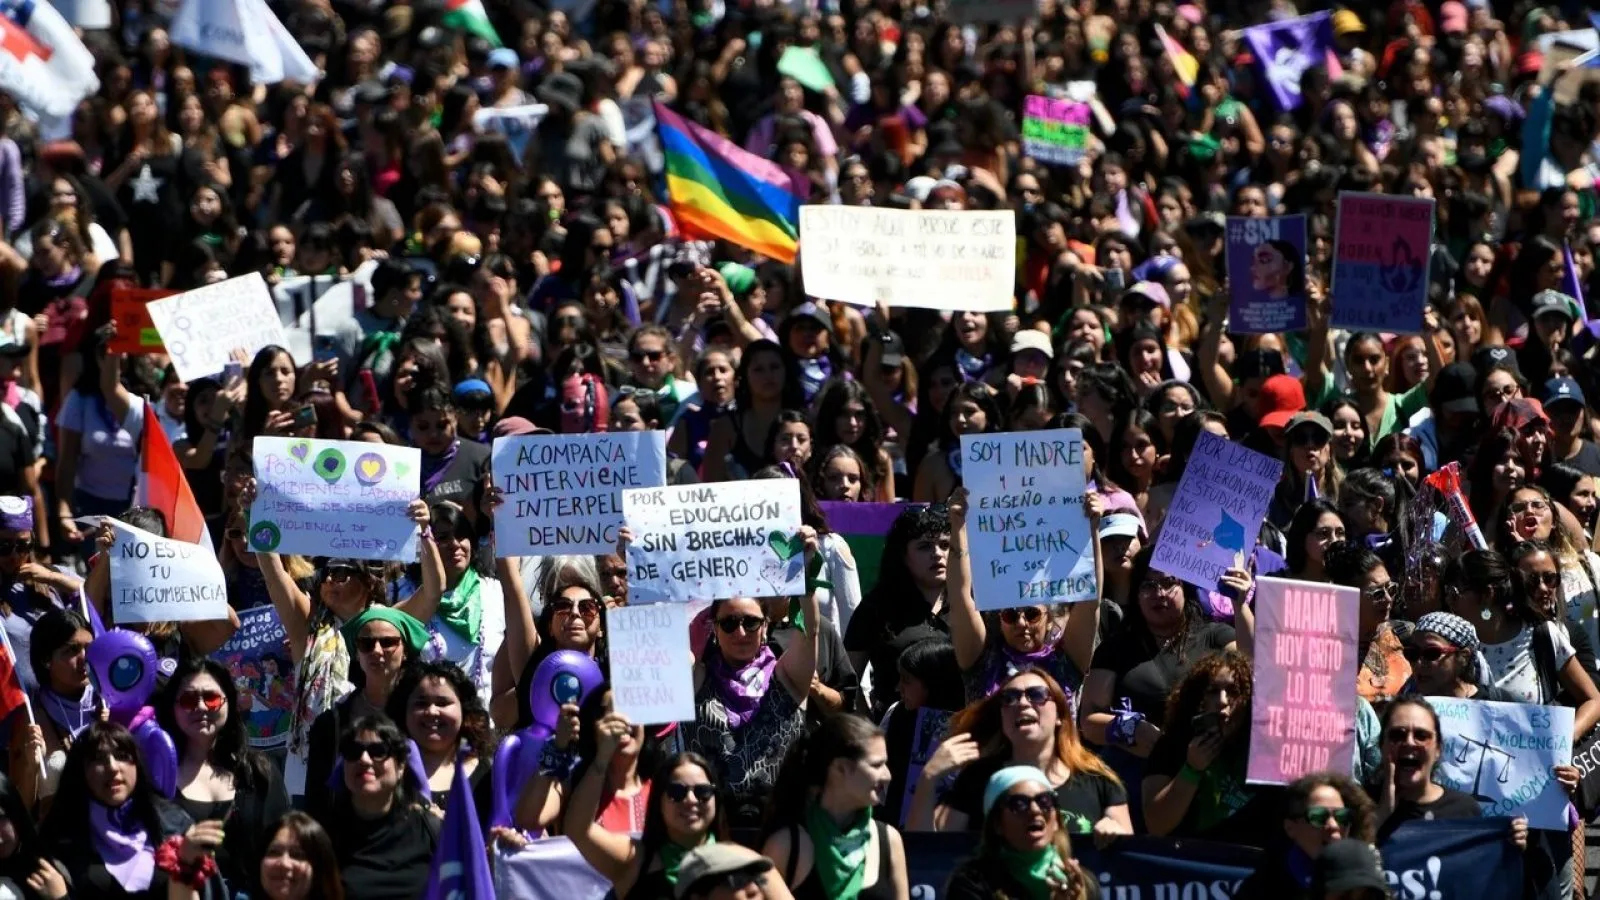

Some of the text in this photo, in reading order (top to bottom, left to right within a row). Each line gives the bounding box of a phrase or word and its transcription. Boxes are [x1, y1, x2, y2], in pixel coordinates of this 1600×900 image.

[516, 438, 626, 467] ACOMPAÑA
[969, 440, 1081, 467] SOY MADRE
[1199, 432, 1280, 483] POR LAS QUE
[262, 481, 350, 496] AMBIENTES
[1021, 476, 1036, 487] LE
[1188, 458, 1247, 498] SALIERON
[263, 501, 409, 517] LIBRES DE SESGOS
[515, 491, 623, 519] INTERPEL
[629, 487, 718, 506] POR UNA
[980, 490, 1042, 509] ENSEÑO
[1175, 496, 1197, 515] NO
[1181, 477, 1263, 521] ESTUDIAR Y
[352, 523, 368, 533] DE
[529, 522, 619, 547] DENUNC
[685, 526, 766, 551] BRECHAS
[1161, 530, 1188, 549] PARA
[120, 541, 150, 560] NO
[154, 541, 176, 559] ES
[1002, 528, 1079, 555] LUCHAR
[149, 564, 171, 580] TU
[635, 562, 660, 581] DE
[1018, 573, 1096, 600] DERECHOS
[1275, 633, 1343, 671] HOY GRITO
[1286, 670, 1332, 707] LO QUE
[1267, 705, 1345, 743] TE HICIERON
[1531, 712, 1550, 729] ES
[1280, 743, 1329, 775] CALLAR
[1099, 872, 1141, 900] in
[1383, 855, 1442, 900] es!
